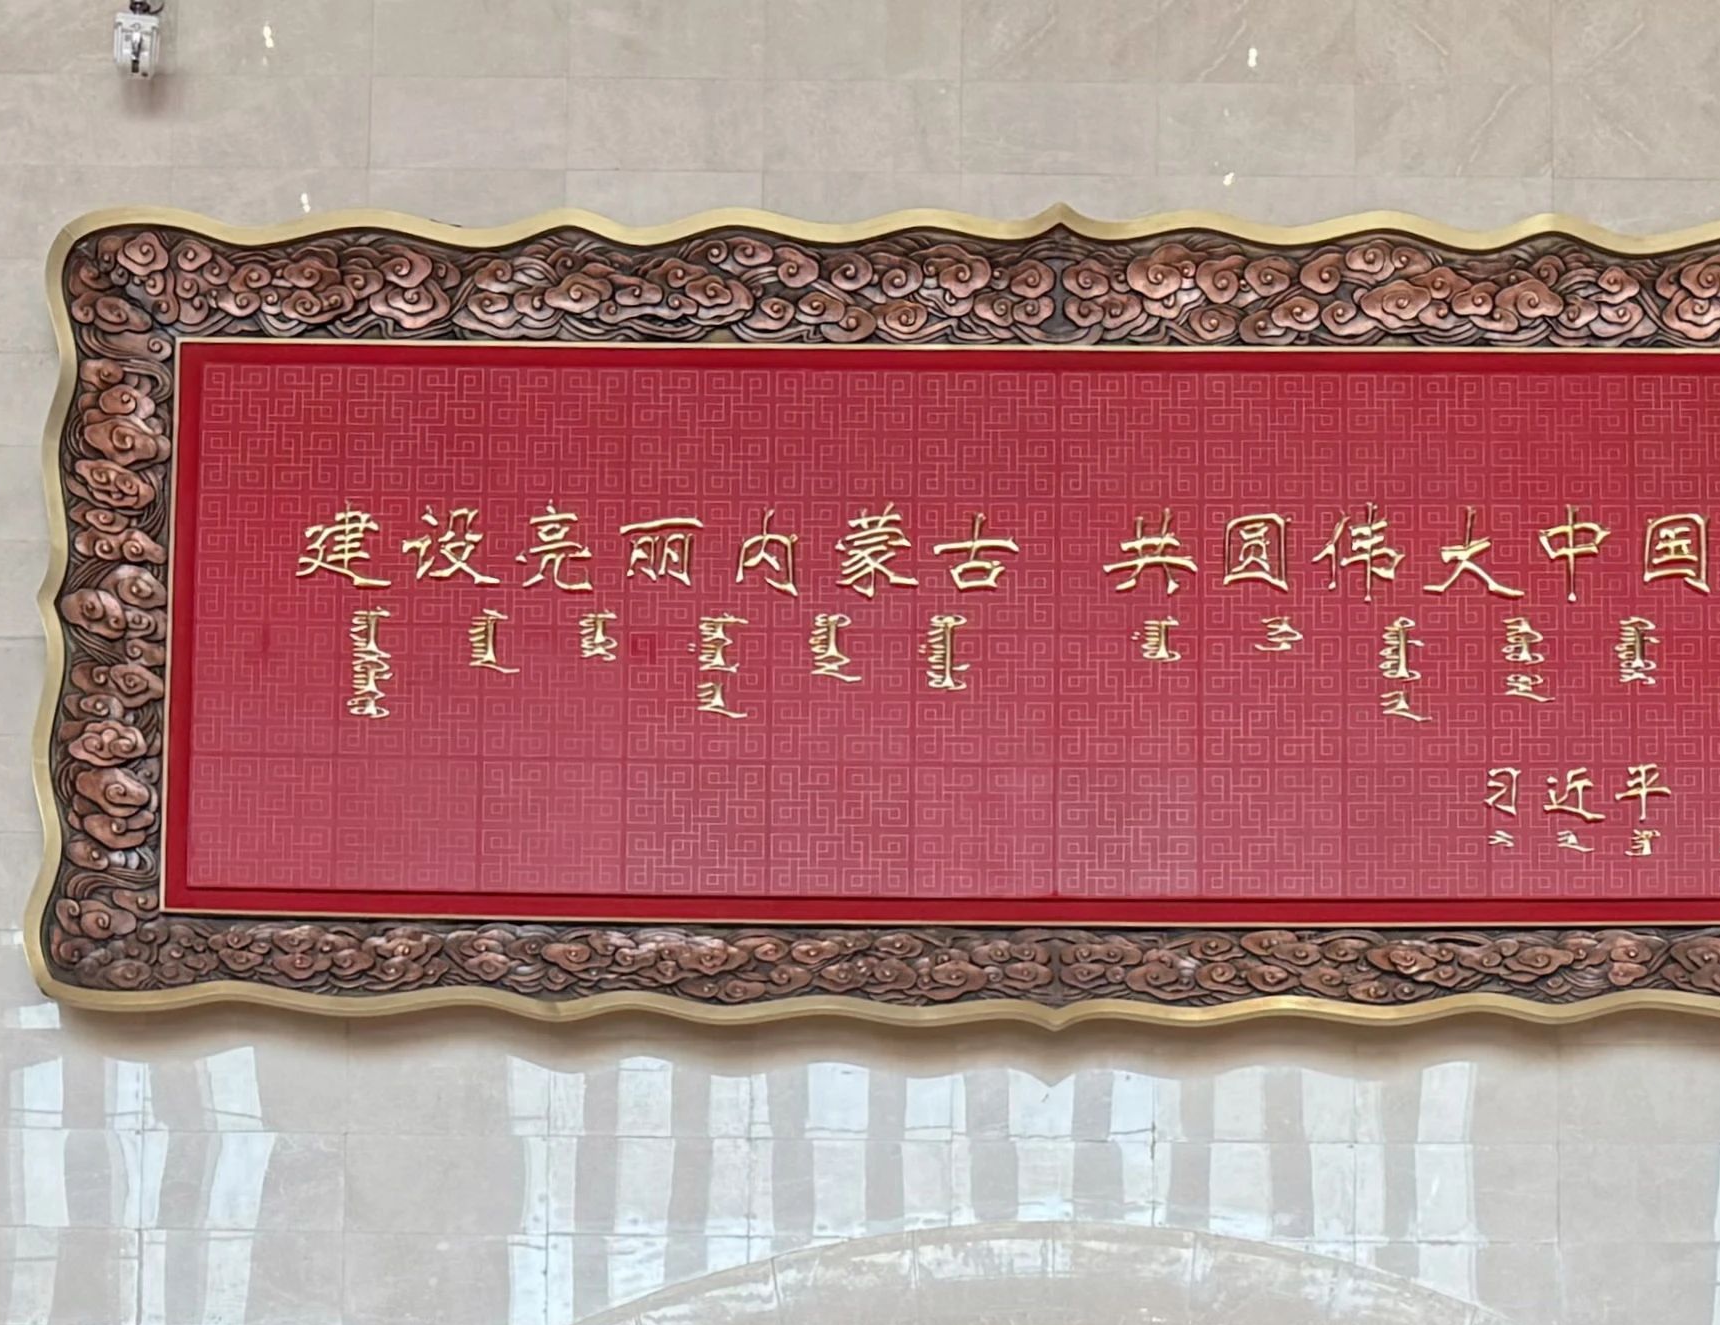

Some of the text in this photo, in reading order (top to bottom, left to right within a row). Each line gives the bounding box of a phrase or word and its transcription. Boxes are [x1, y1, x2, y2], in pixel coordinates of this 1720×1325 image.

[295, 498, 1020, 598] 建设亮丽内蒙古
[1484, 764, 1672, 822] 习近平
